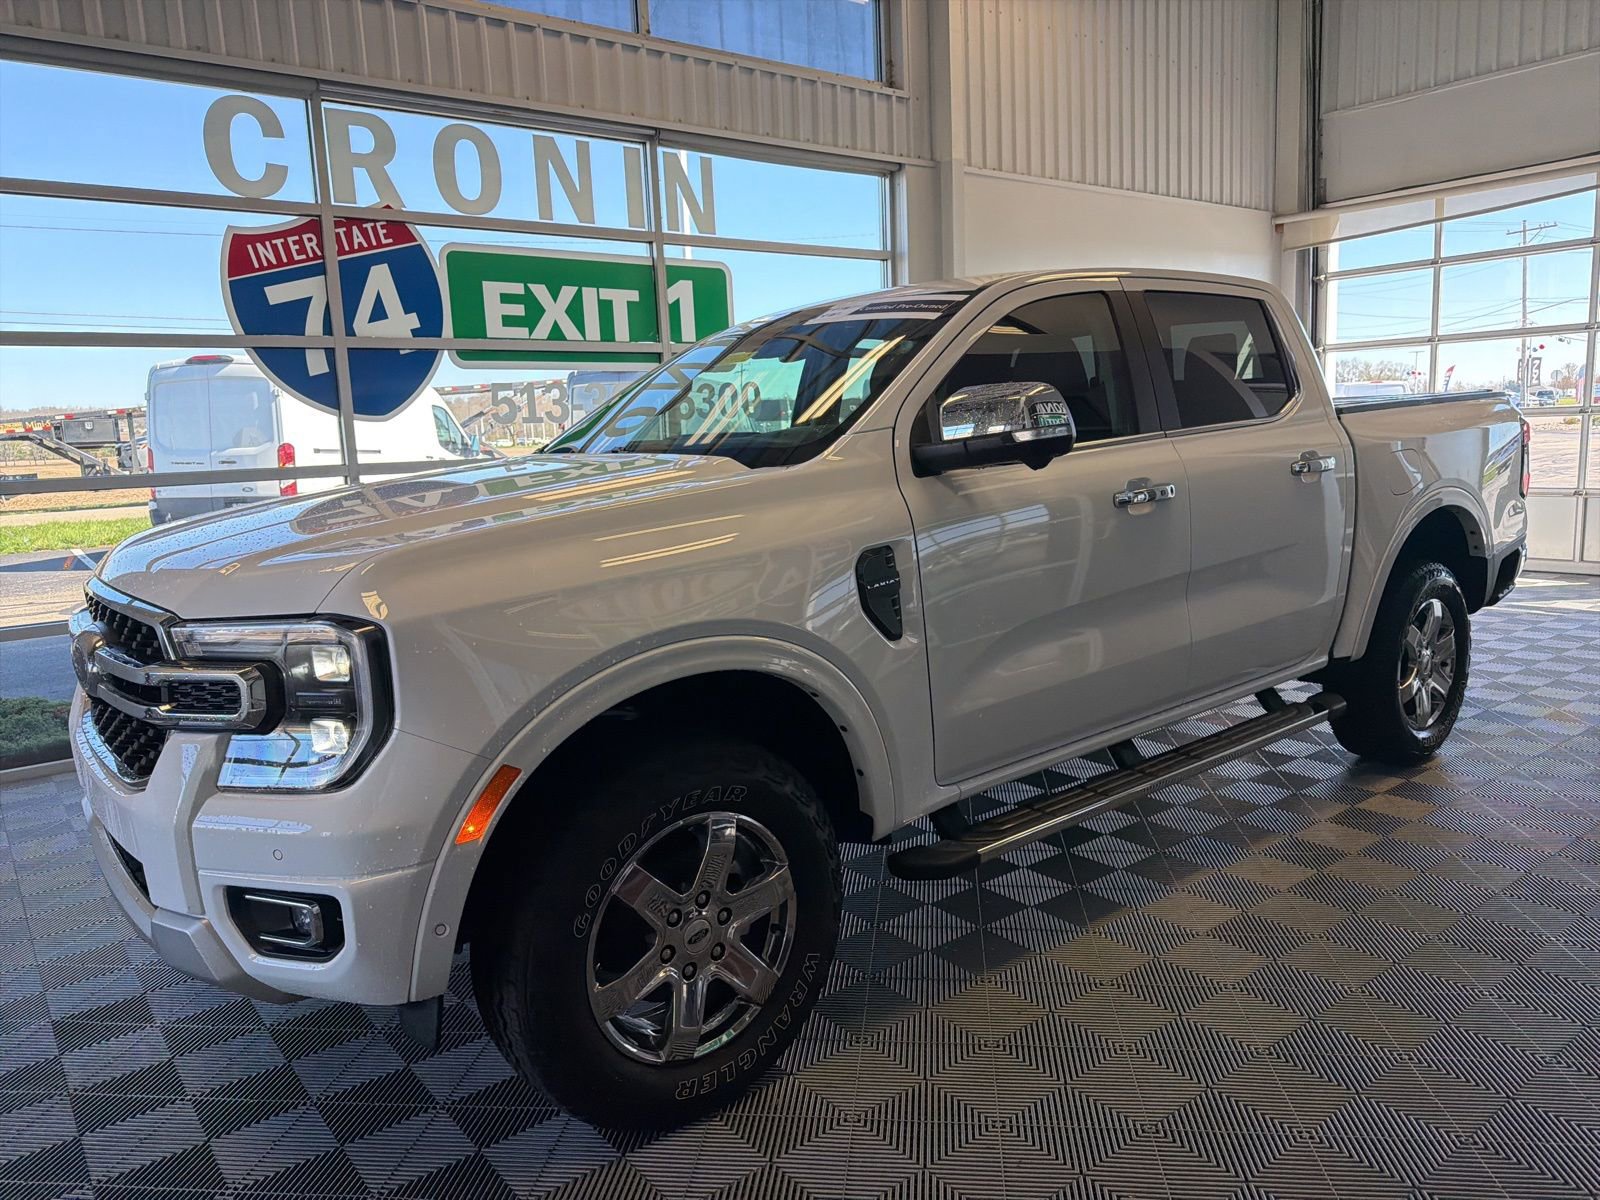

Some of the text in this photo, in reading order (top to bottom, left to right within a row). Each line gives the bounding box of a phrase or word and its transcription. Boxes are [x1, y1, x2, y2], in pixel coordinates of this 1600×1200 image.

[203, 94, 716, 236] CRONIN
[246, 220, 394, 269] INTERTATE
[263, 262, 421, 377] 74
[482, 279, 697, 342] EXIT 1
[573, 784, 748, 938] GOODYEAR
[674, 952, 821, 1101] WRANGLER
